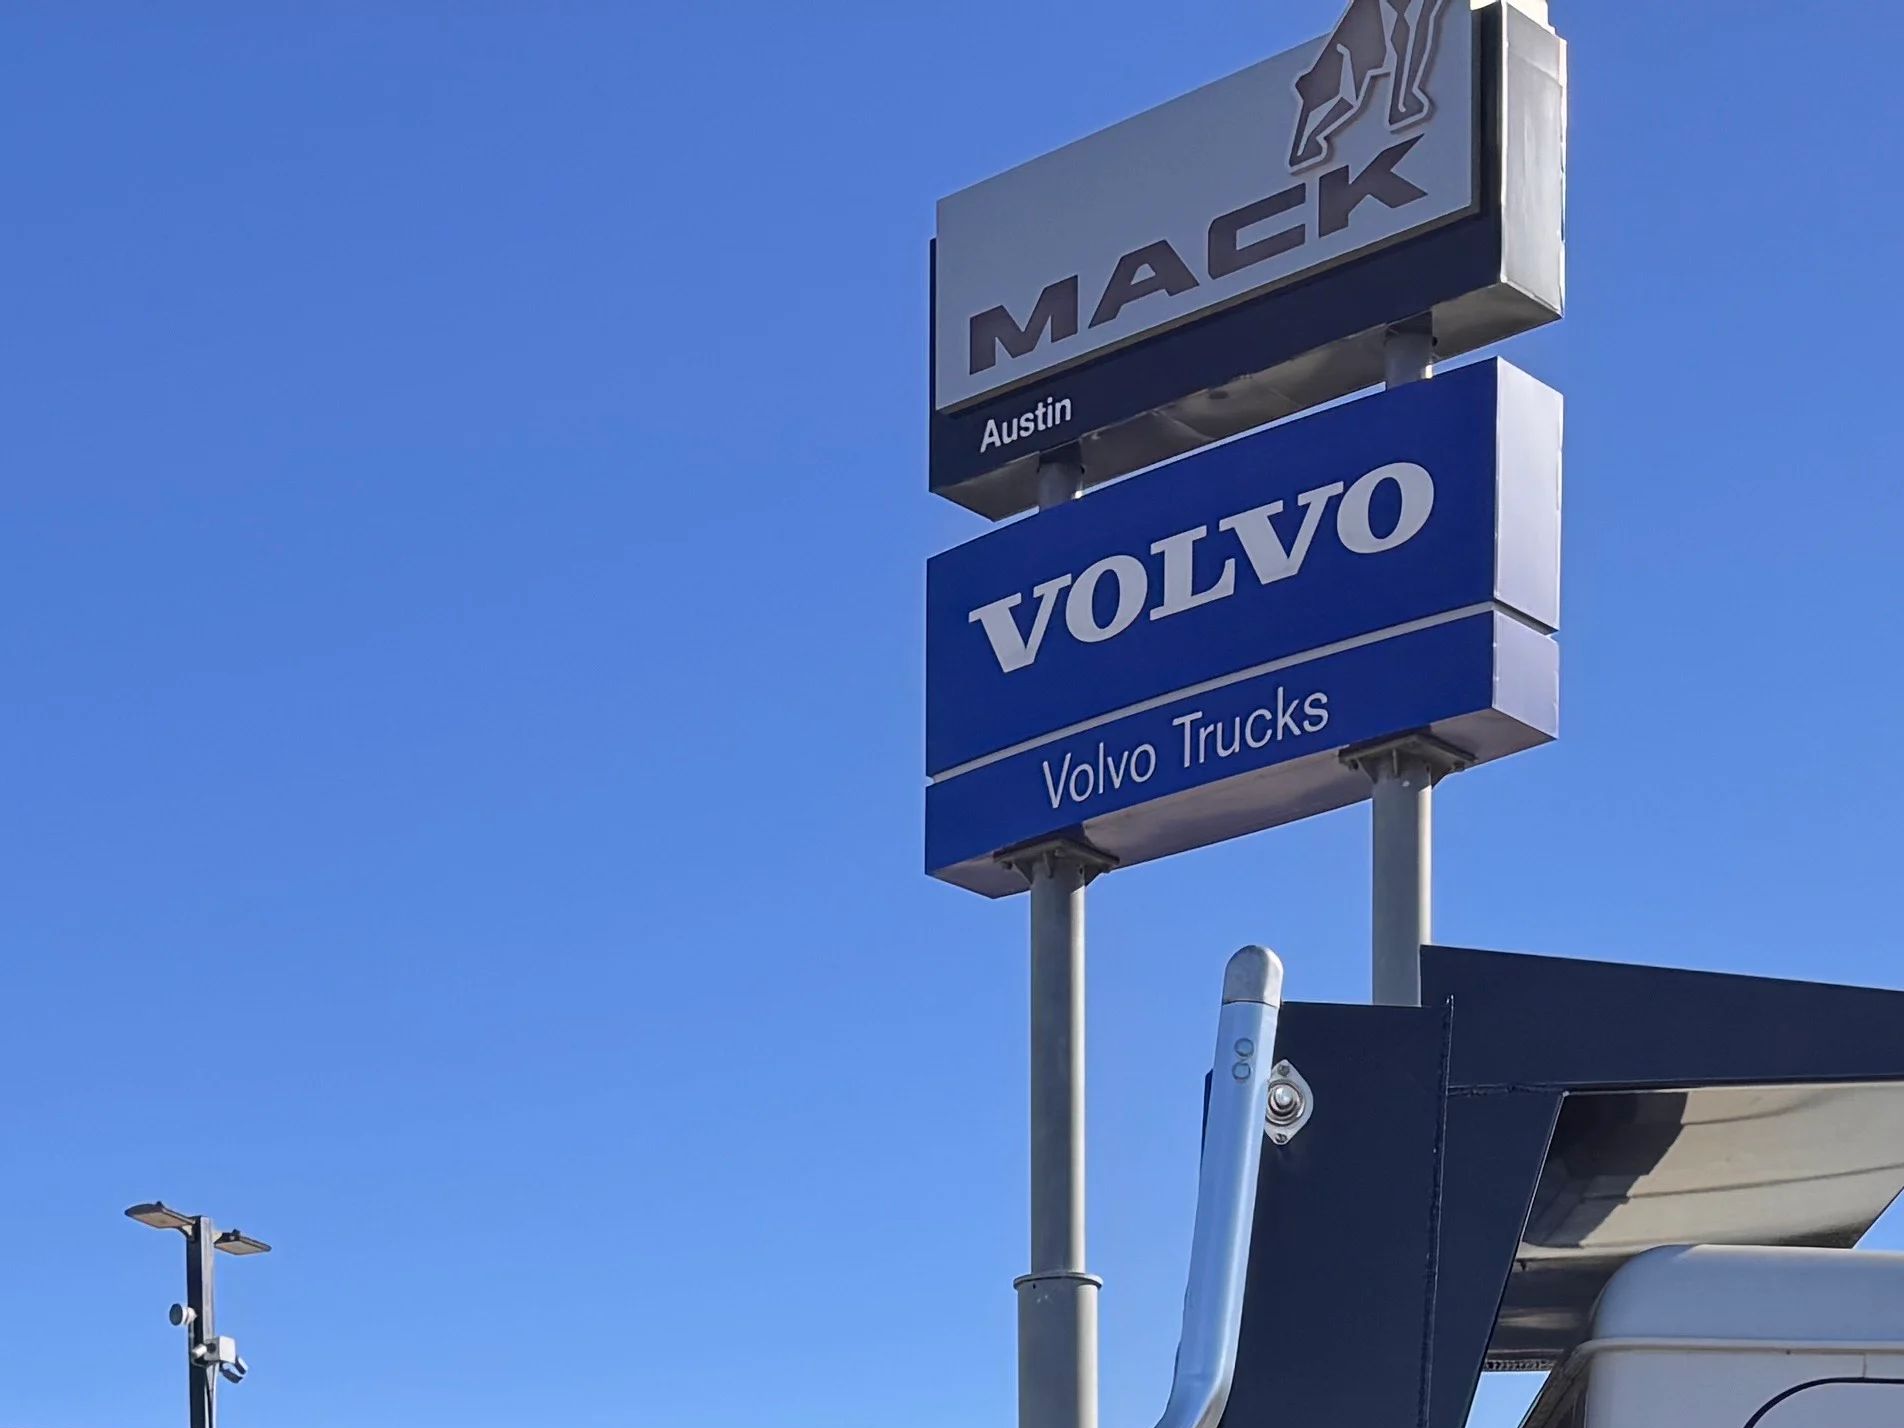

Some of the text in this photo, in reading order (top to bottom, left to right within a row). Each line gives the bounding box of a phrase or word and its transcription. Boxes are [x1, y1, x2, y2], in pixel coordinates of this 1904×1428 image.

[969, 134, 1427, 375] MACK
[980, 395, 1072, 453] Austin
[969, 461, 1435, 674] VOLVO
[1042, 686, 1330, 809] Volvo Trucks
